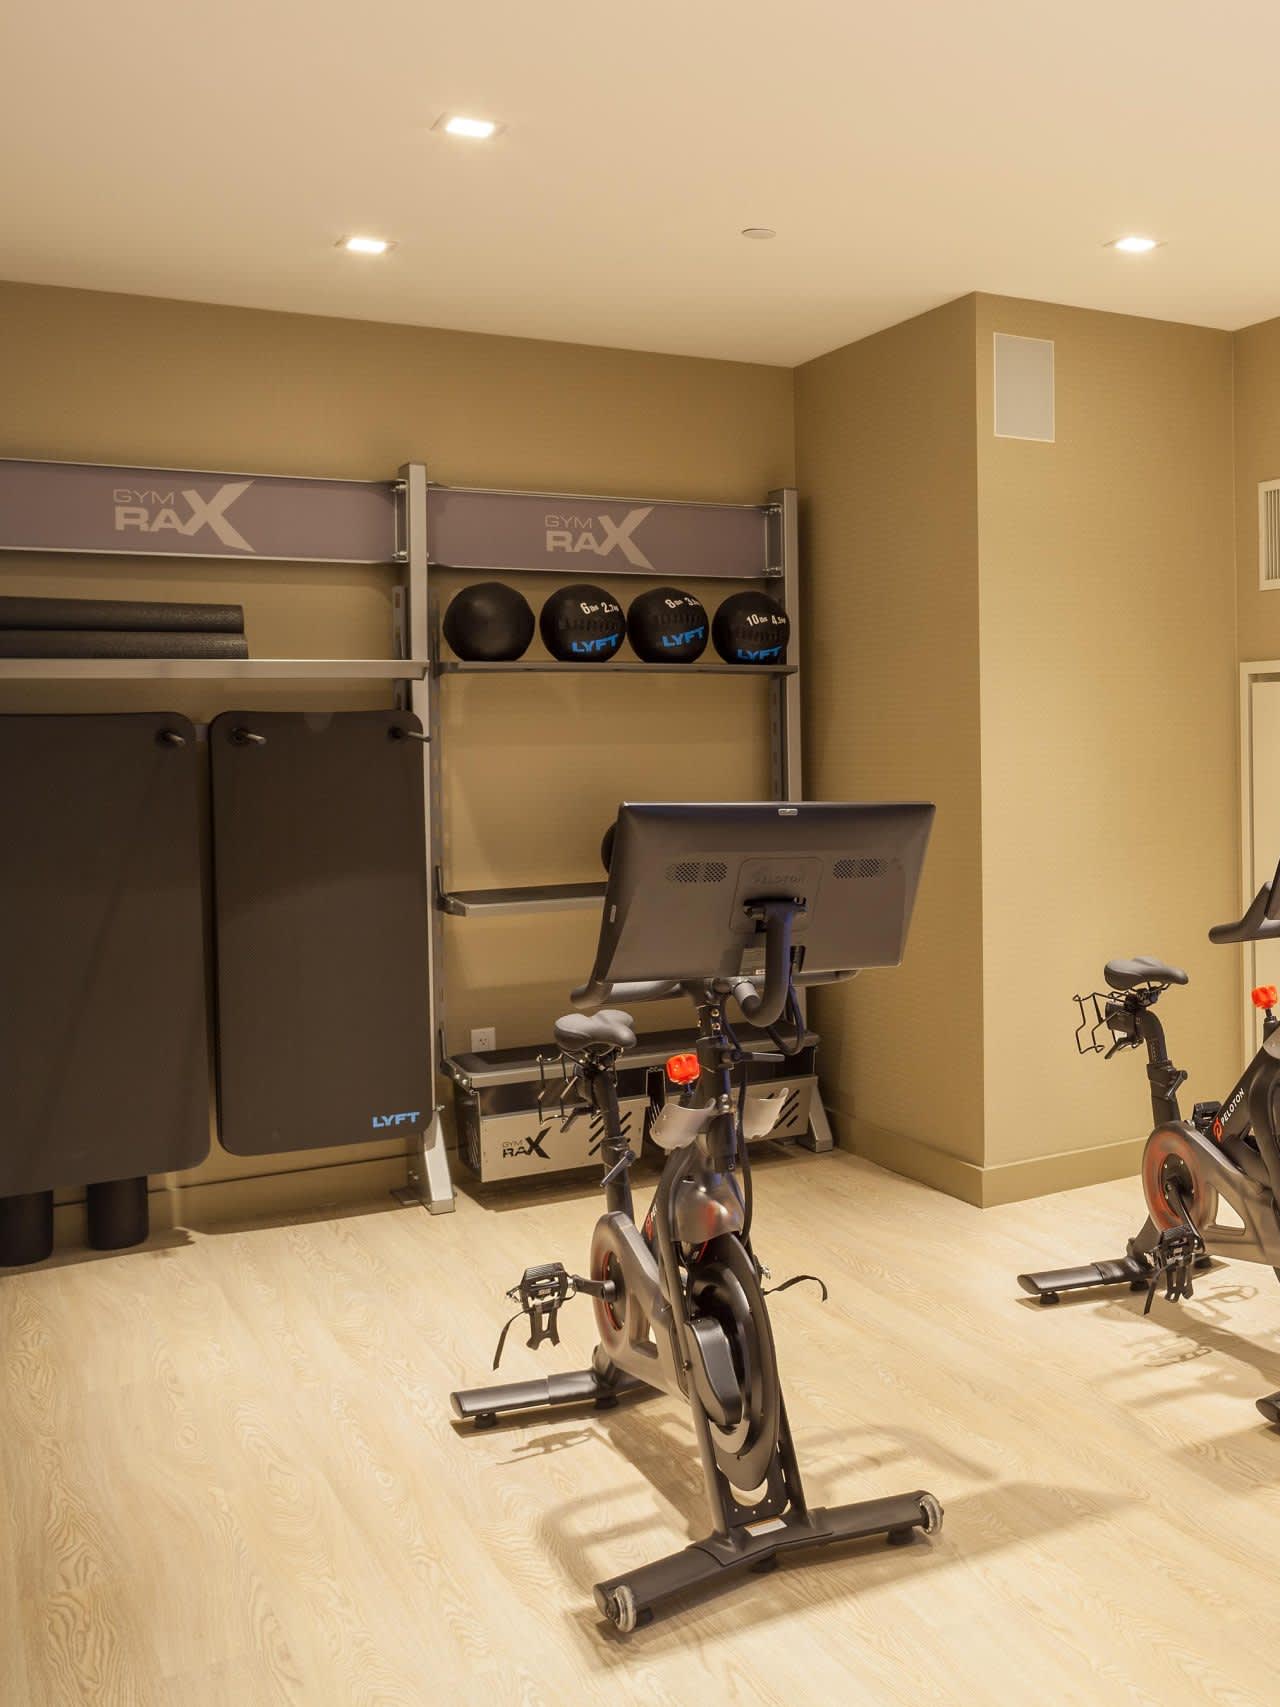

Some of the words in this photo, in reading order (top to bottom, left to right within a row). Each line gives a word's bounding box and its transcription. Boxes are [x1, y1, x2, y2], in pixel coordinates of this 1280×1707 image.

[113, 489, 175, 504] GYM
[545, 515, 593, 529] GYM
[571, 633, 619, 653] LYFT
[661, 626, 705, 648] LYFT
[737, 645, 783, 661] LYFT
[1220, 1088, 1245, 1126] PELOTON
[372, 1111, 420, 1128] LYFT
